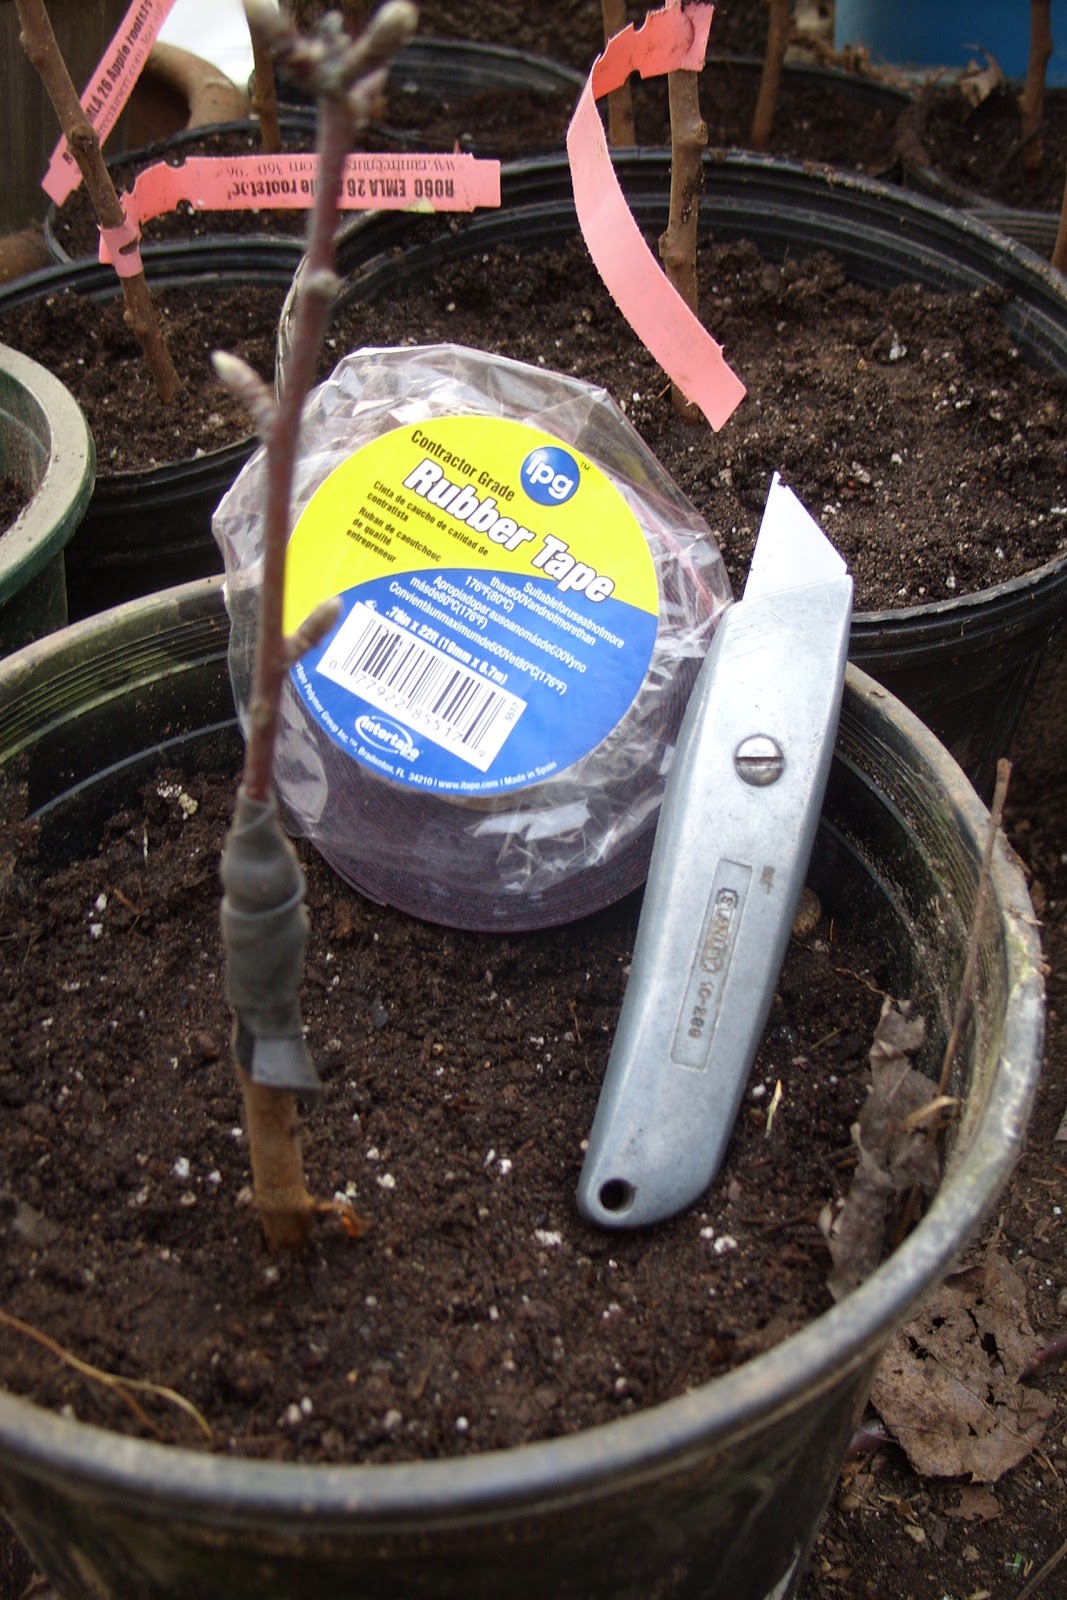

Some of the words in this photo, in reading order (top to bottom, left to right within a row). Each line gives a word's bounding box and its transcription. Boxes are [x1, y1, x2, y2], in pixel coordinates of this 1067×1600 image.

[346, 179, 365, 198] 26
[368, 178, 406, 199] EMLA
[410, 430, 478, 478] Contractor
[478, 469, 515, 502] Grade
[525, 453, 573, 499] ipg
[352, 517, 363, 529] de
[367, 492, 409, 523] contratista
[373, 481, 395, 499] Cinta
[396, 494, 405, 506] de
[405, 500, 437, 521] caucho
[437, 515, 447, 528] de
[447, 521, 479, 548] calidad
[478, 544, 489, 556] de
[402, 457, 535, 552] Rubber
[531, 534, 615, 602] Tape
[345, 529, 397, 563] entrepreneur
[359, 507, 385, 527] Ruban
[385, 521, 396, 532] de
[396, 526, 442, 562] caoutchouc
[409, 621, 420, 632] x
[469, 656, 480, 666] x
[321, 712, 341, 735] Group
[408, 773, 433, 786] 34210
[504, 772, 525, 785] Made
[526, 769, 534, 777] in
[534, 760, 557, 775] Spain
